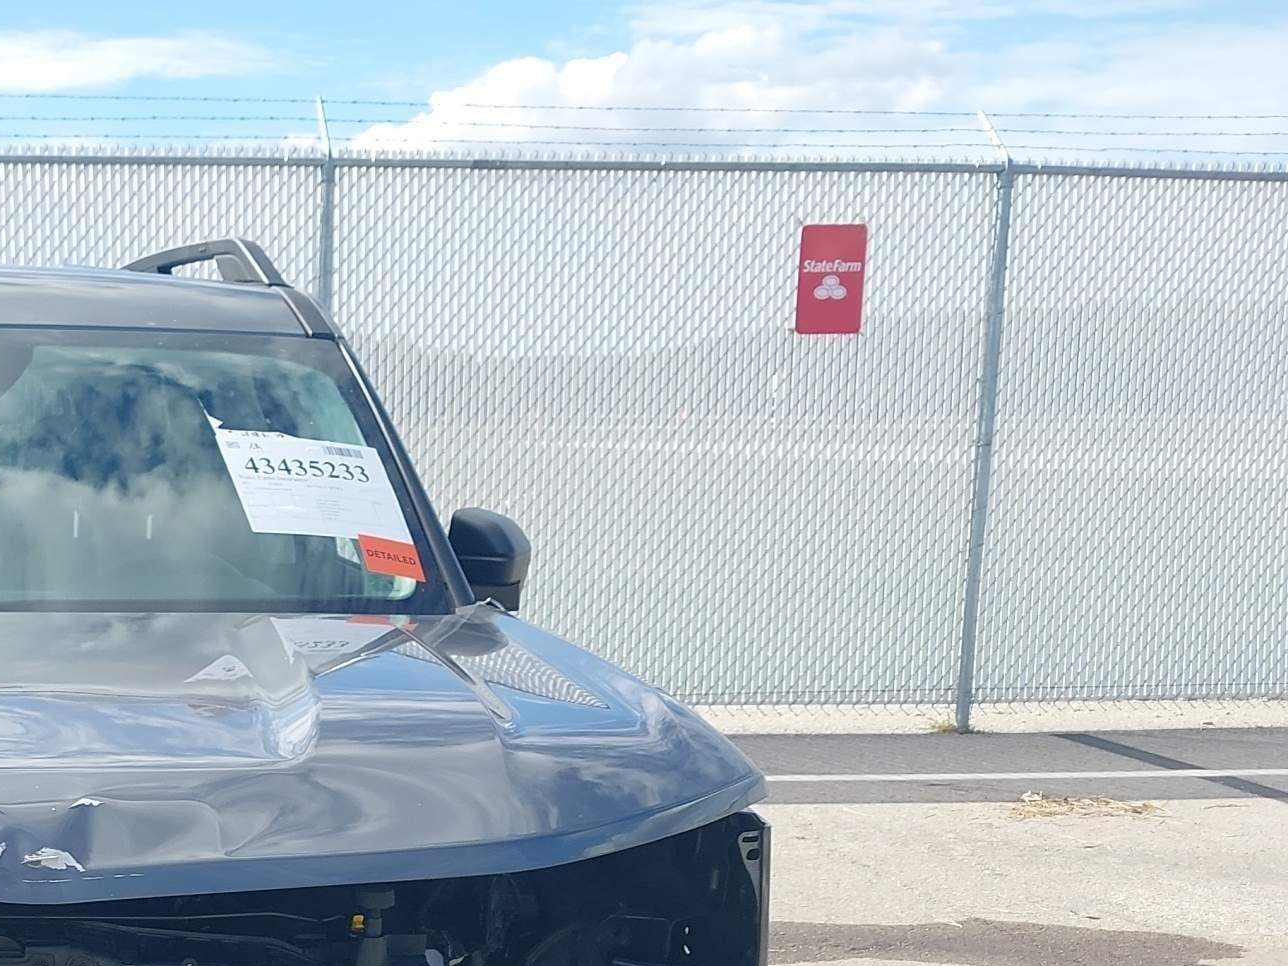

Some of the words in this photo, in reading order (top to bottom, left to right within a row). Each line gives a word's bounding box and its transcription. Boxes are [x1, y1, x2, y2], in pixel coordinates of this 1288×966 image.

[803, 259, 862, 273] StateFarm
[244, 457, 370, 483] 43435233
[366, 548, 416, 566] DETAILED
